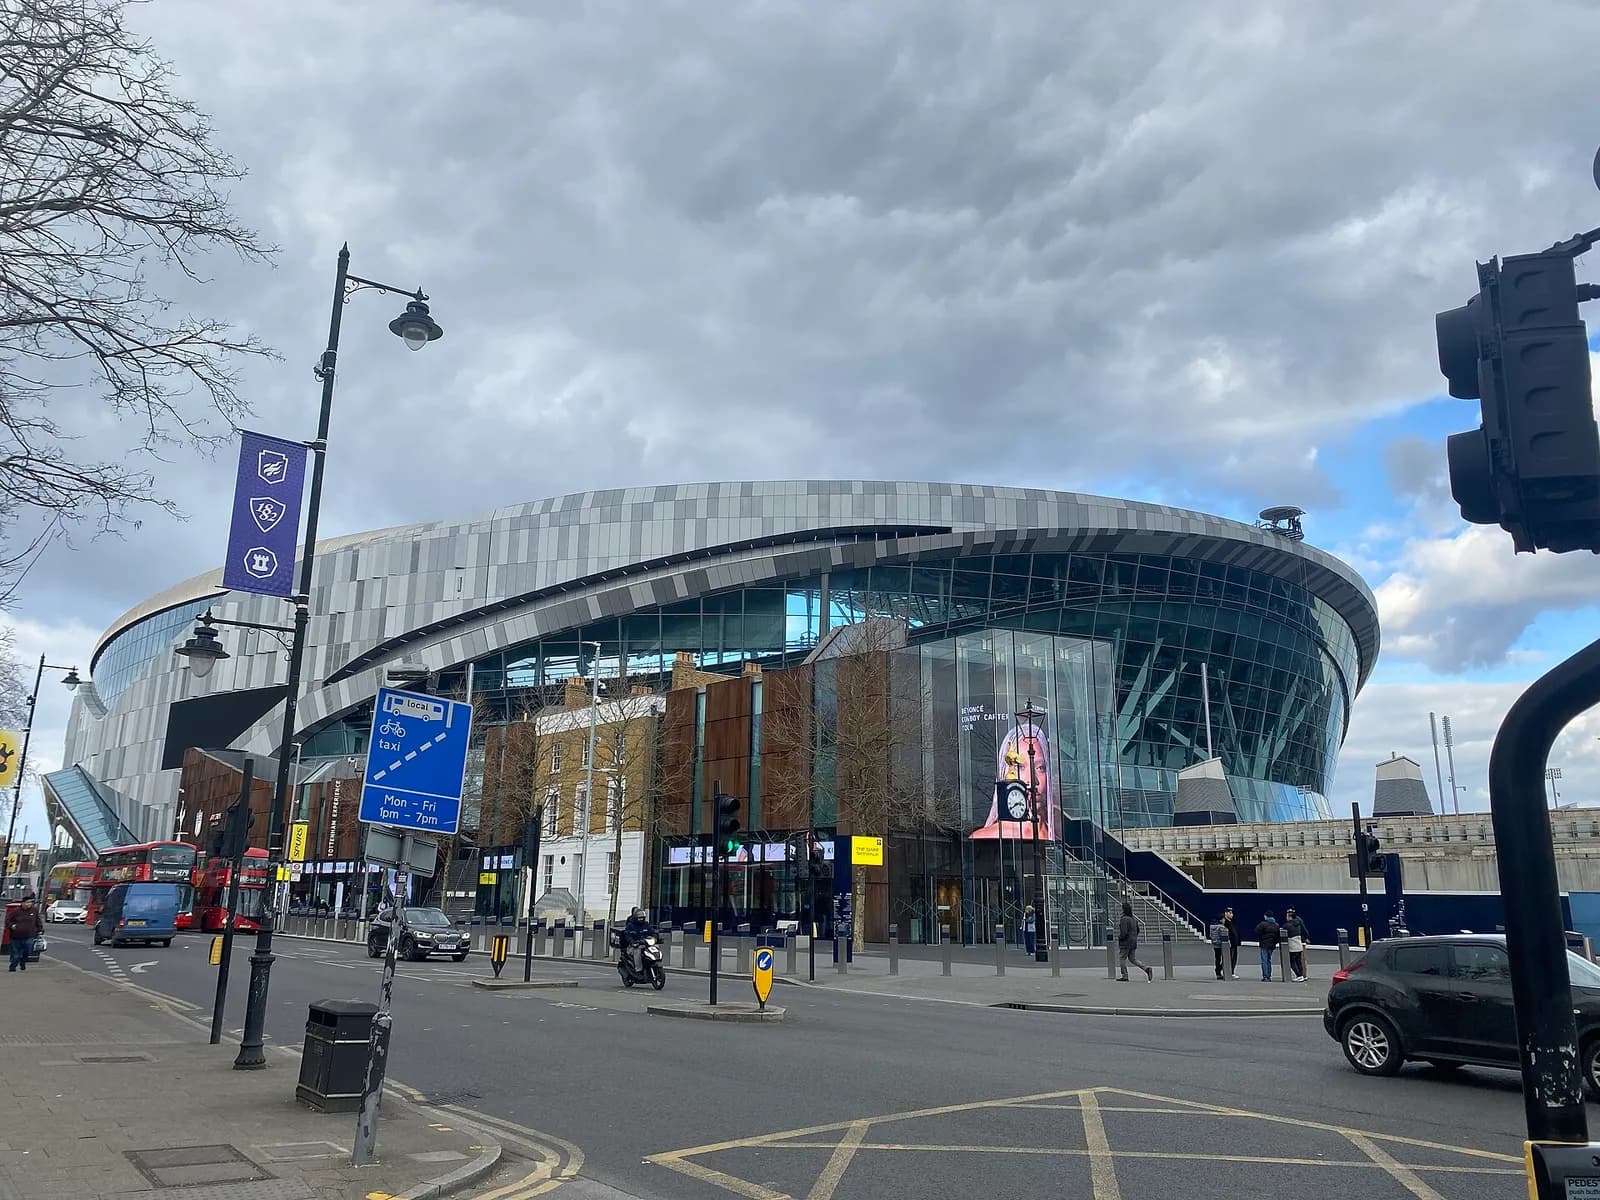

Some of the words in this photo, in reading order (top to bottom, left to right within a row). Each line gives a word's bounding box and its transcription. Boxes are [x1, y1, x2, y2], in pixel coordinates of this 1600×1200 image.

[255, 503, 278, 522] 1882
[407, 700, 429, 711] local
[379, 738, 401, 752] taxi
[384, 794, 407, 808] Mon
[422, 800, 437, 812] Fri
[327, 820, 337, 857] TOTTENHAM
[332, 780, 341, 819] EXPERIENCE
[379, 807, 399, 819] 1pm
[415, 812, 438, 825] 7pm
[294, 827, 303, 857] SPURS
[1568, 1179, 1600, 1187] PEDES
